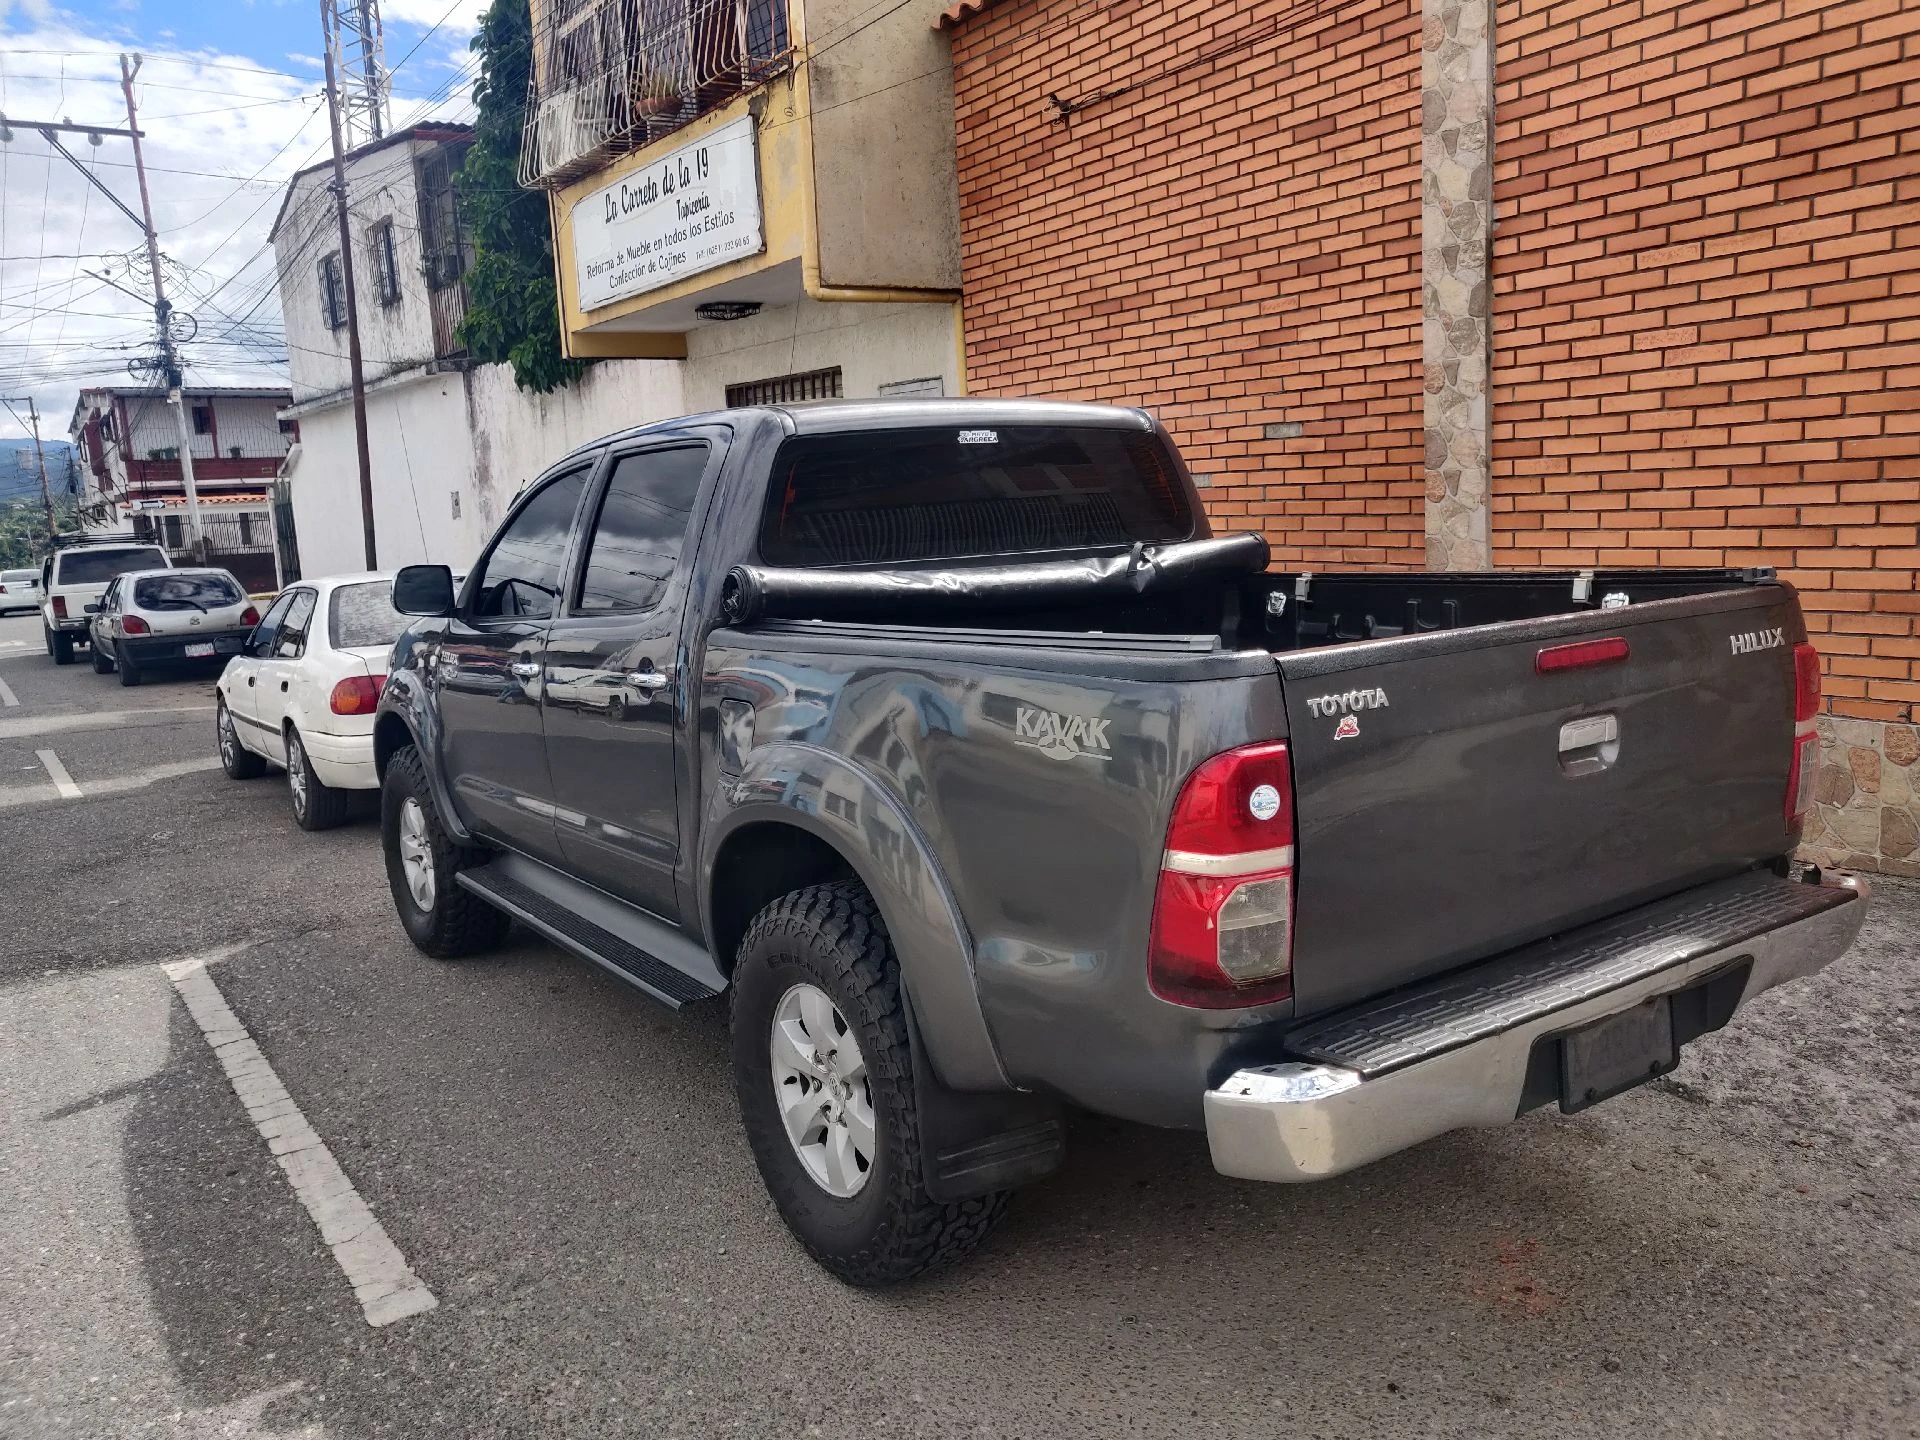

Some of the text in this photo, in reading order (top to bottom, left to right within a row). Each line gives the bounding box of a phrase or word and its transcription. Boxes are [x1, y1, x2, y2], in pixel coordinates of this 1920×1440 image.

[605, 147, 709, 224] La Carreta de la 19
[586, 210, 735, 279] Reforma de Mueble en todos los Estilos
[609, 251, 687, 289] Confección de Cojines
[1729, 627, 1785, 655] HILUX
[1307, 688, 1389, 718] TOYOTA
[1016, 707, 1111, 750] KAVAK
